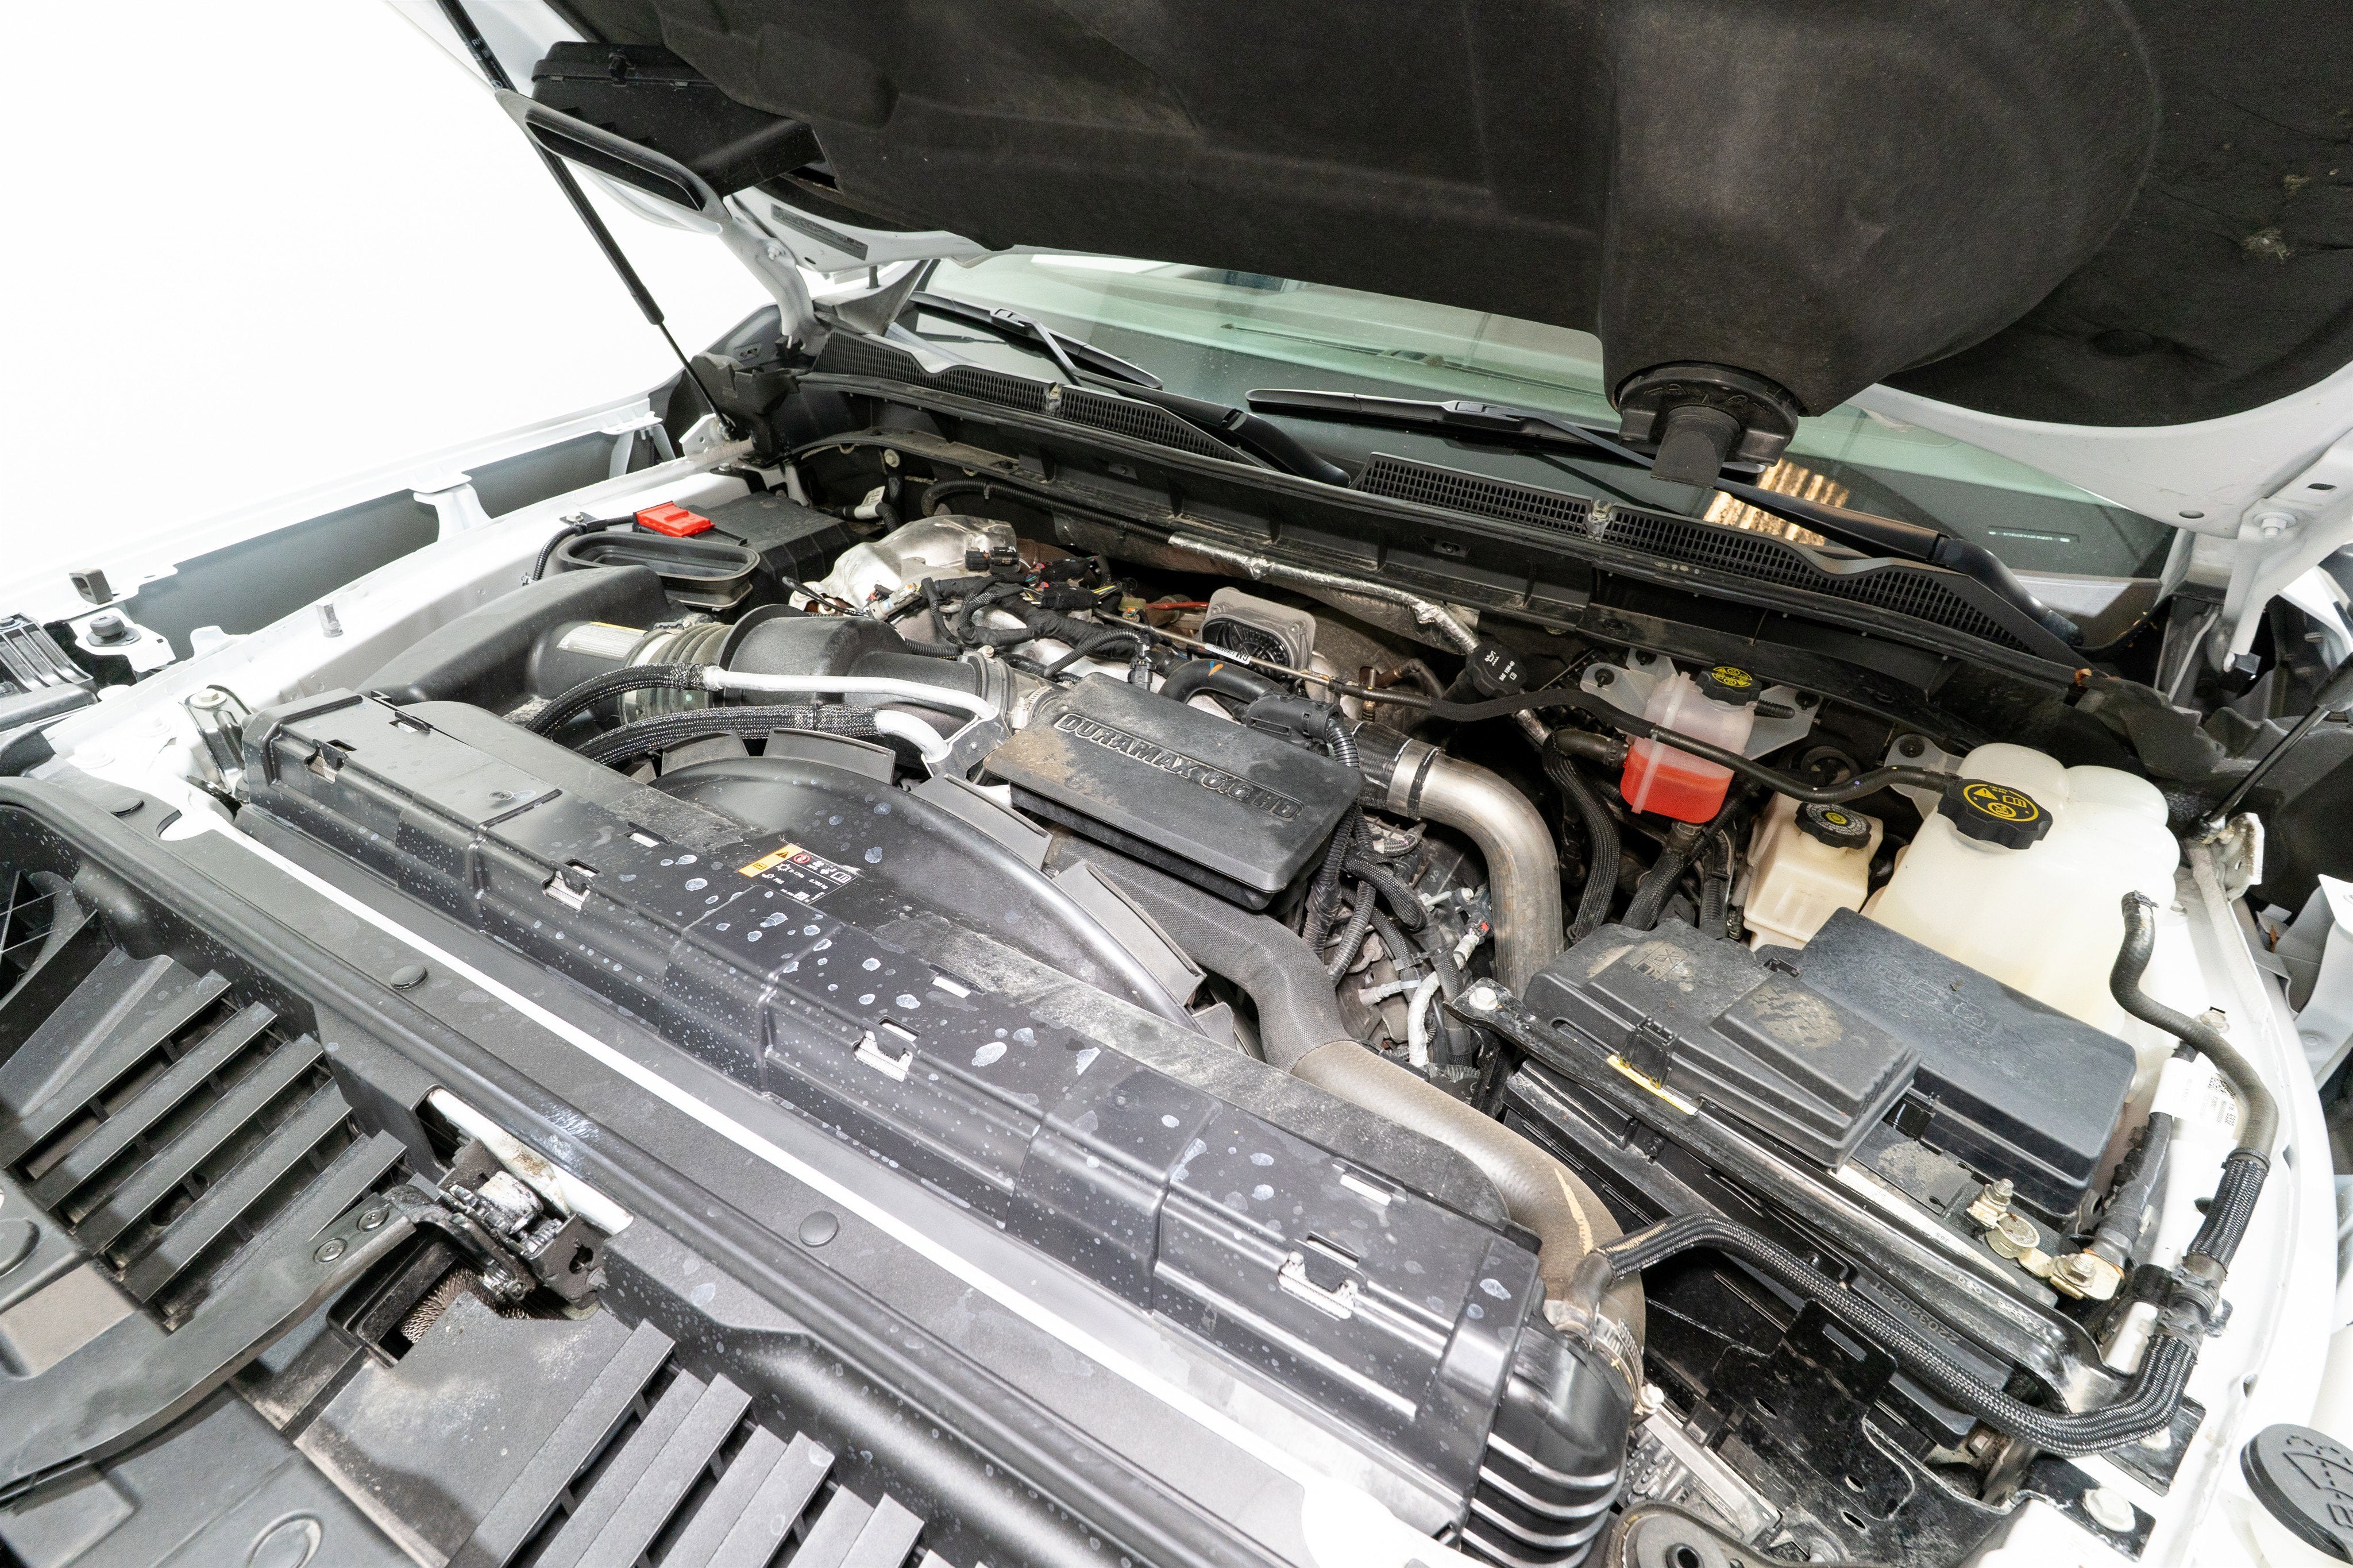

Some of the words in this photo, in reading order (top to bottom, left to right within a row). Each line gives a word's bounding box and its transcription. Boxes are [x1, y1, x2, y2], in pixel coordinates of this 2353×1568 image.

[472, 37, 483, 47] RH
[1236, 652, 1249, 661] GM
[1057, 715, 1198, 779] DURAMAX
[1201, 769, 1254, 801] 6.6
[1253, 792, 1301, 819] HD
[1935, 1232, 1950, 1243] 365
